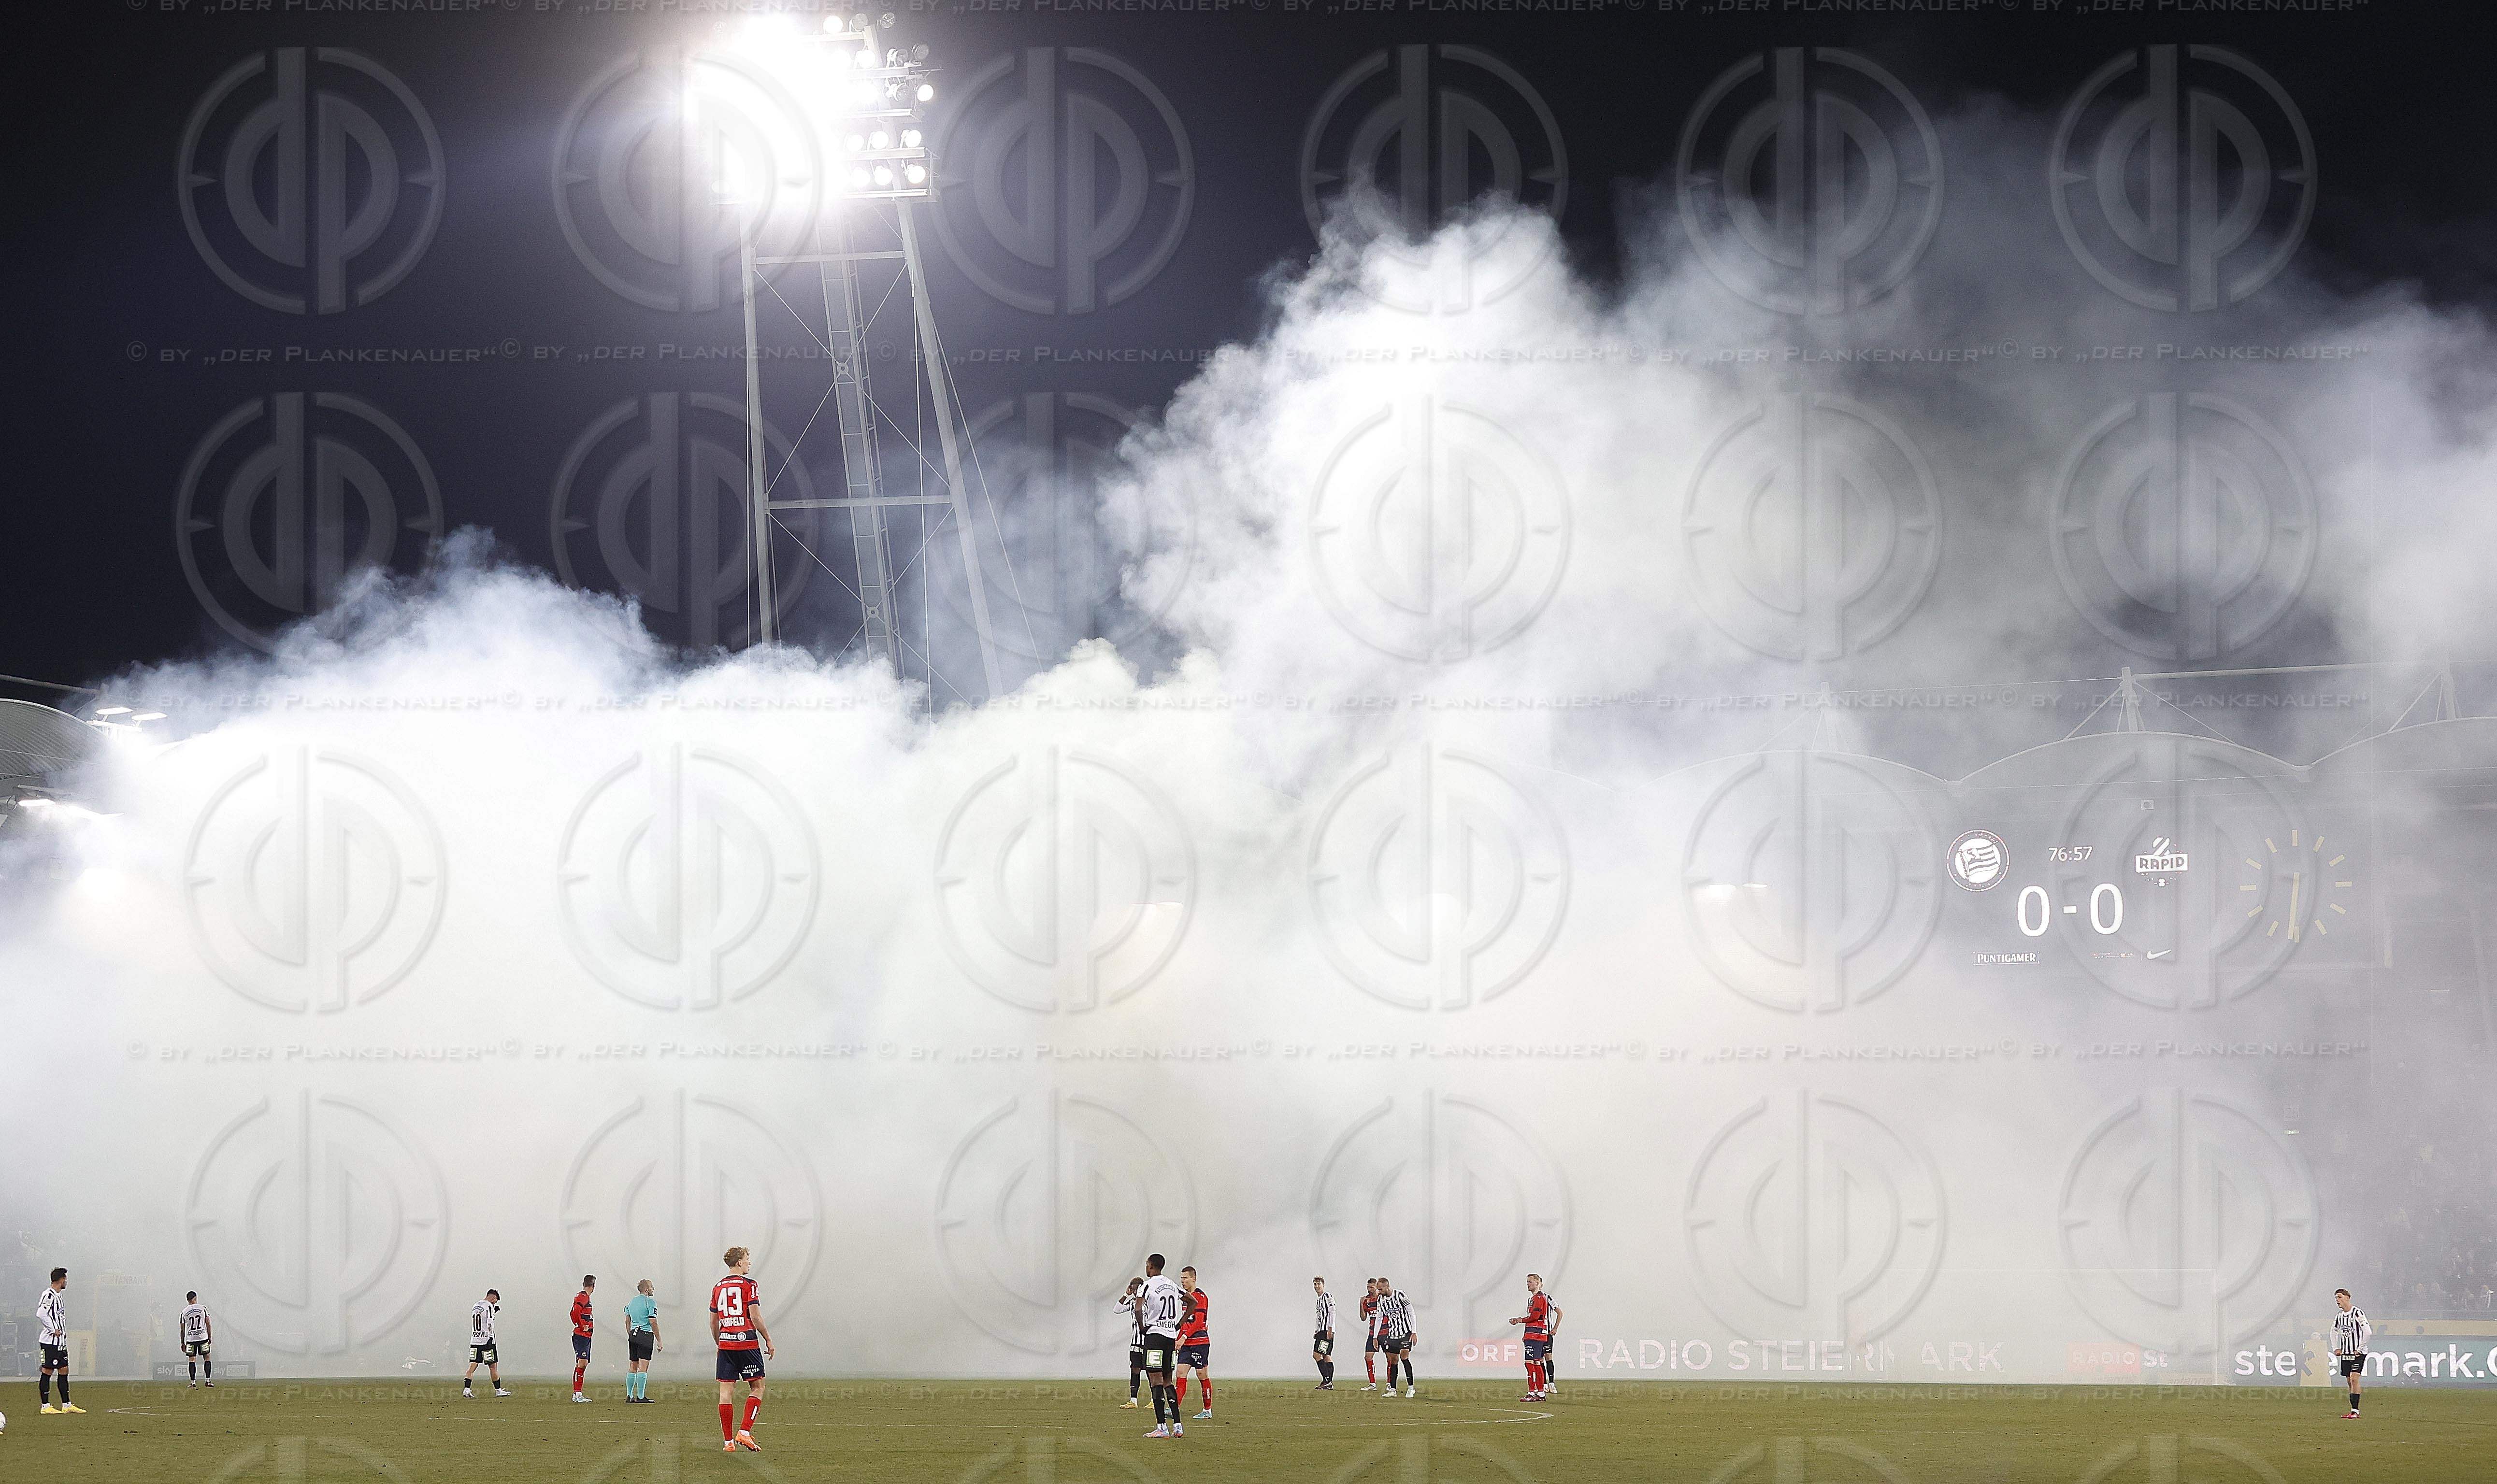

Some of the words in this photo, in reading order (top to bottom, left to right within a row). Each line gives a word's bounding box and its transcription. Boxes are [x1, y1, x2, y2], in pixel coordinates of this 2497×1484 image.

[2049, 846, 2093, 861] 76:57
[2139, 856, 2185, 870] RAPID
[2017, 885, 2050, 937] 0
[2090, 883, 2124, 934] 0
[1978, 952, 2037, 963] PUNTIGAMER
[718, 1286, 743, 1317] 43
[1159, 1295, 1176, 1320] 20
[189, 1315, 202, 1330] 22
[473, 1314, 481, 1331] 10
[1148, 1351, 1160, 1366] E
[1462, 1343, 1517, 1362] ORF
[1580, 1339, 1713, 1370] RADIO
[158, 1366, 174, 1376] sky
